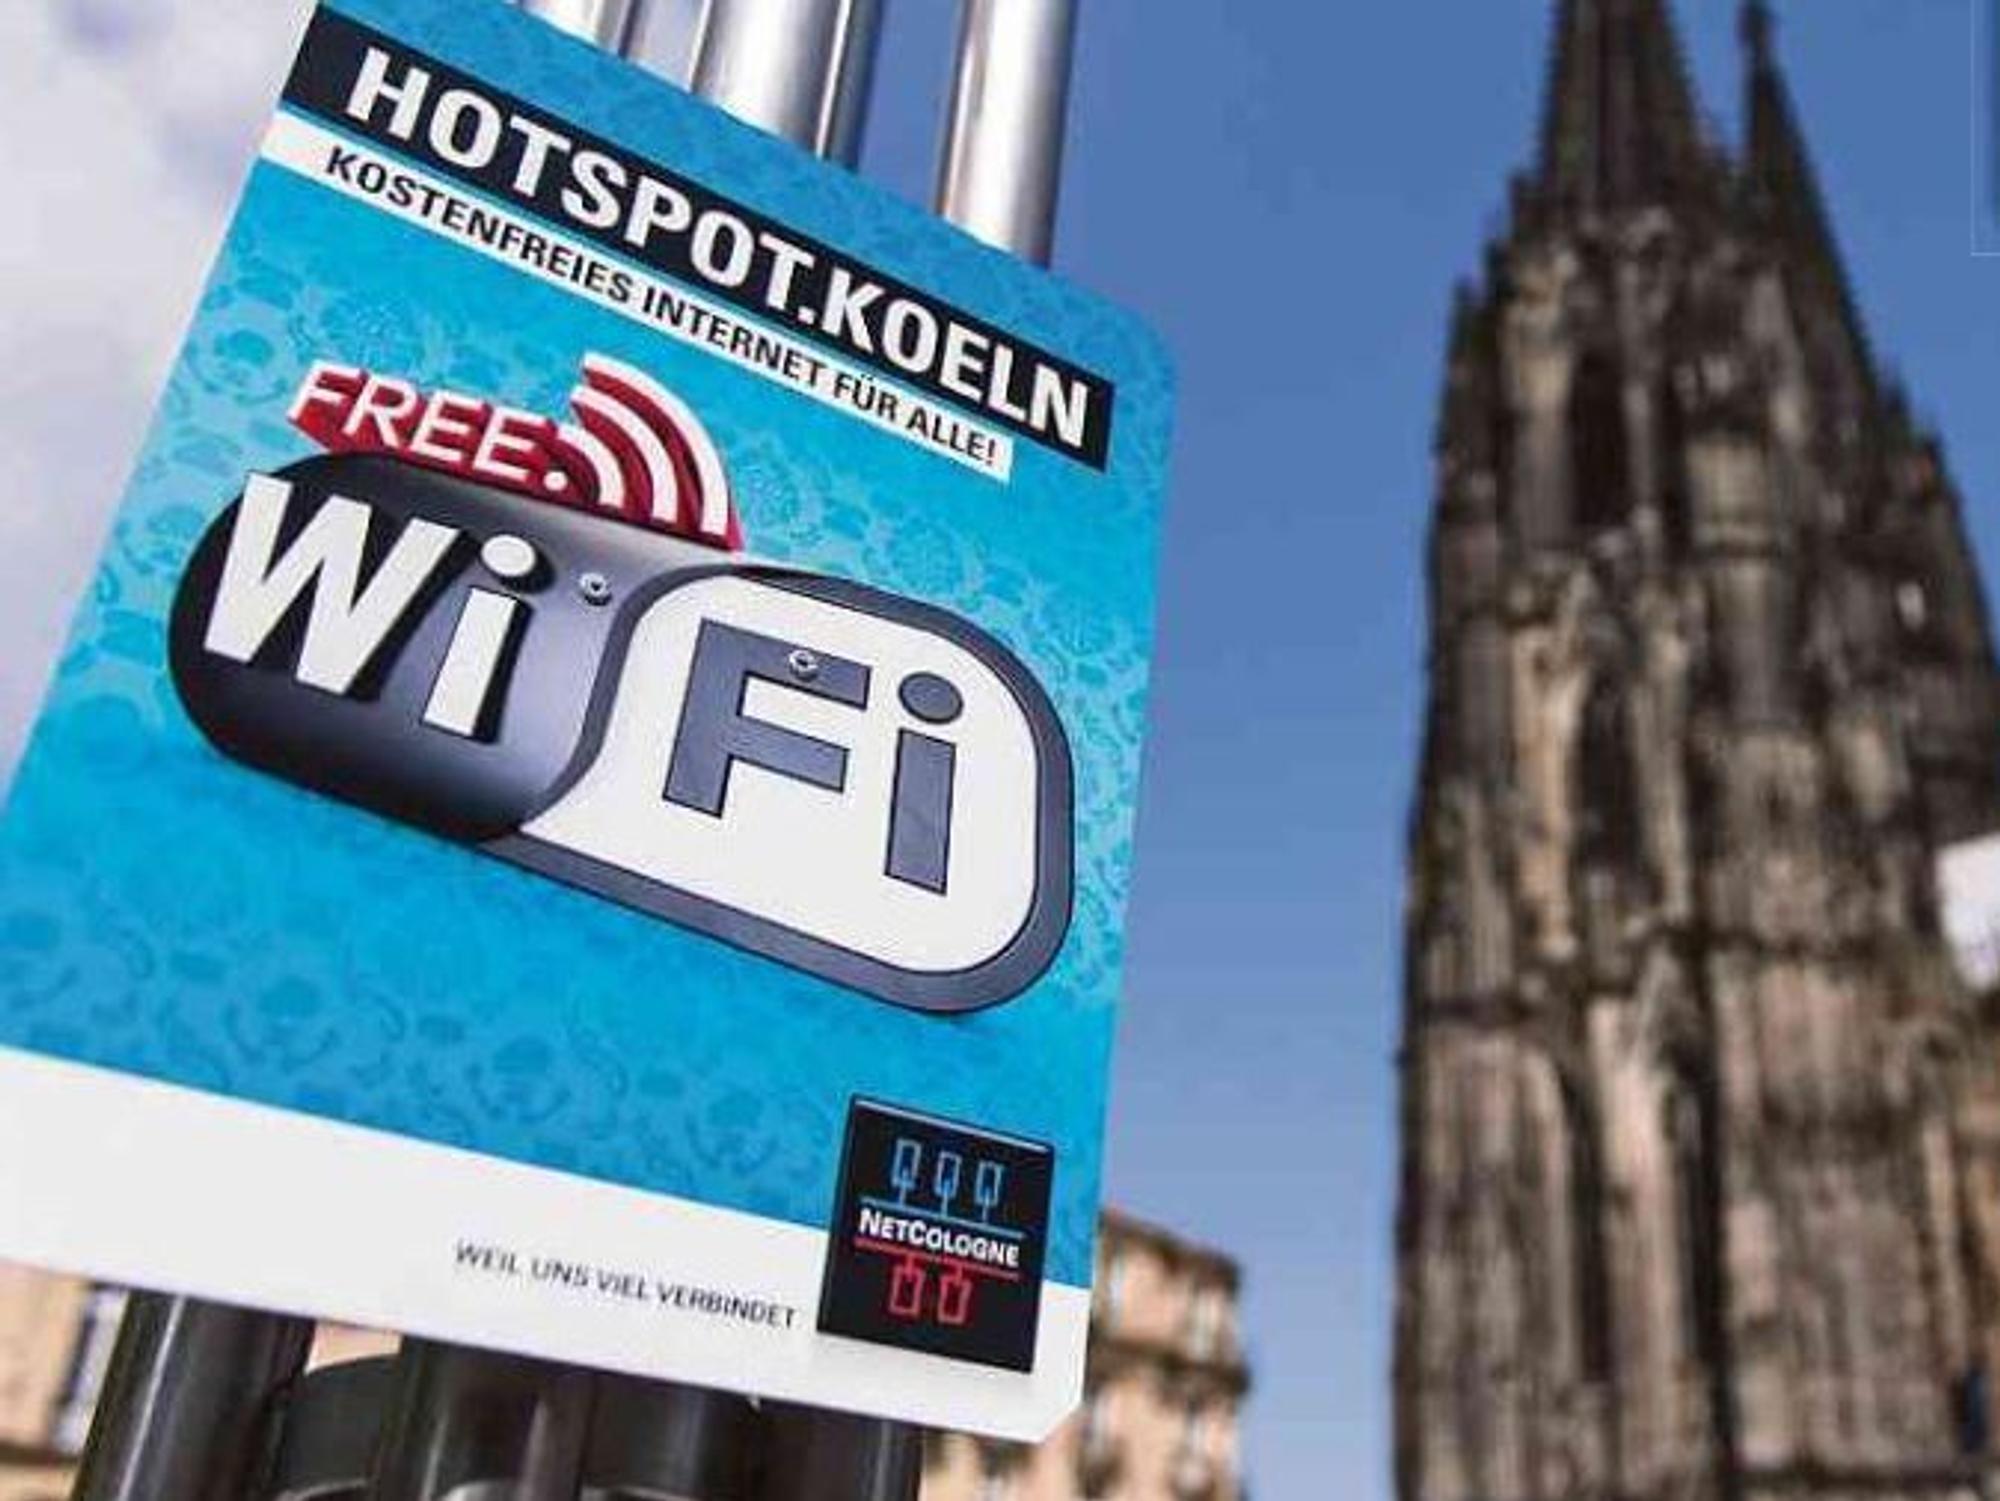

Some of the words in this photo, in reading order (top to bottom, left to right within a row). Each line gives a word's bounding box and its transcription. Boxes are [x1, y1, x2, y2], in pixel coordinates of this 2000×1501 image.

[325, 145, 634, 307] KOSTENFREIES
[641, 284, 827, 391] INTERNET
[834, 371, 902, 424] FÜR
[904, 407, 998, 466] ALLE!
[345, 46, 1091, 451] HOTSPOT.KOELN
[455, 1237, 522, 1278] WEIL
[531, 1257, 591, 1289] UNS
[597, 1269, 652, 1303] VIEL
[656, 1280, 798, 1330] VERBINDET
